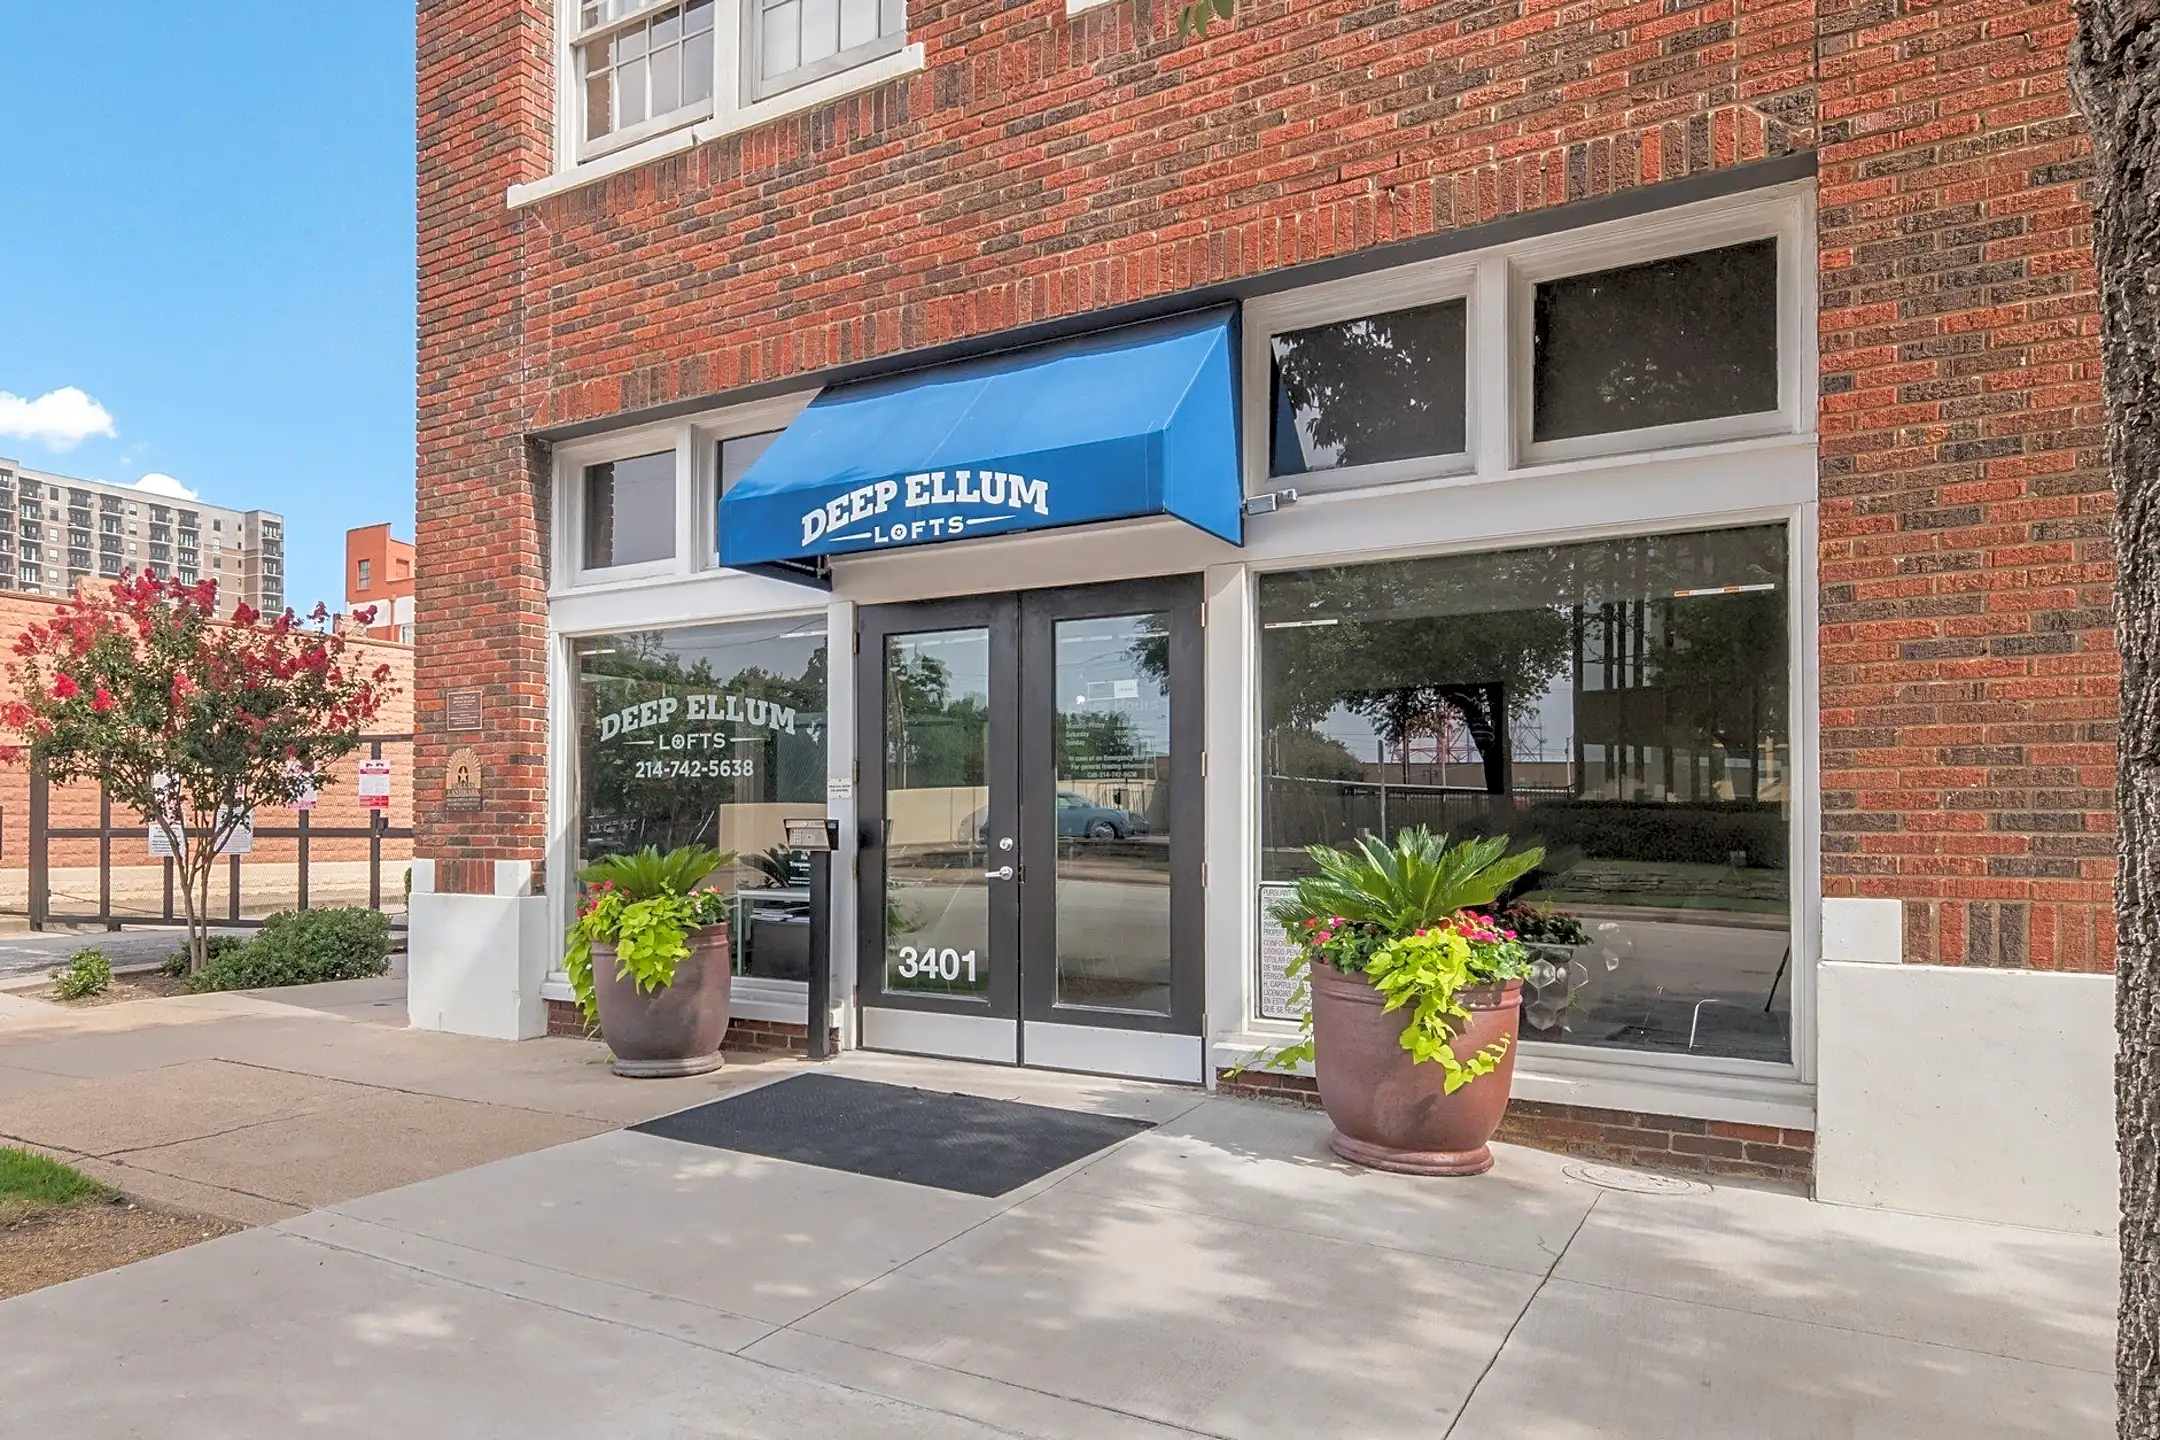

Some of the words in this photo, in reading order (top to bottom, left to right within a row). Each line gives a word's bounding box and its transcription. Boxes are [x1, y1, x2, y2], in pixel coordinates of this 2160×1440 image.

[801, 480, 898, 547] DEEP
[905, 470, 1049, 516] ELLUM
[874, 516, 964, 543] LOFTS
[600, 697, 678, 742] DEEP
[686, 694, 796, 735] ELLUM
[659, 733, 726, 750] LOFTS
[635, 759, 754, 778] 214-742-5638
[1080, 763, 1101, 771] general
[1263, 888, 1291, 898] PURSUANT
[898, 946, 976, 982] 3401
